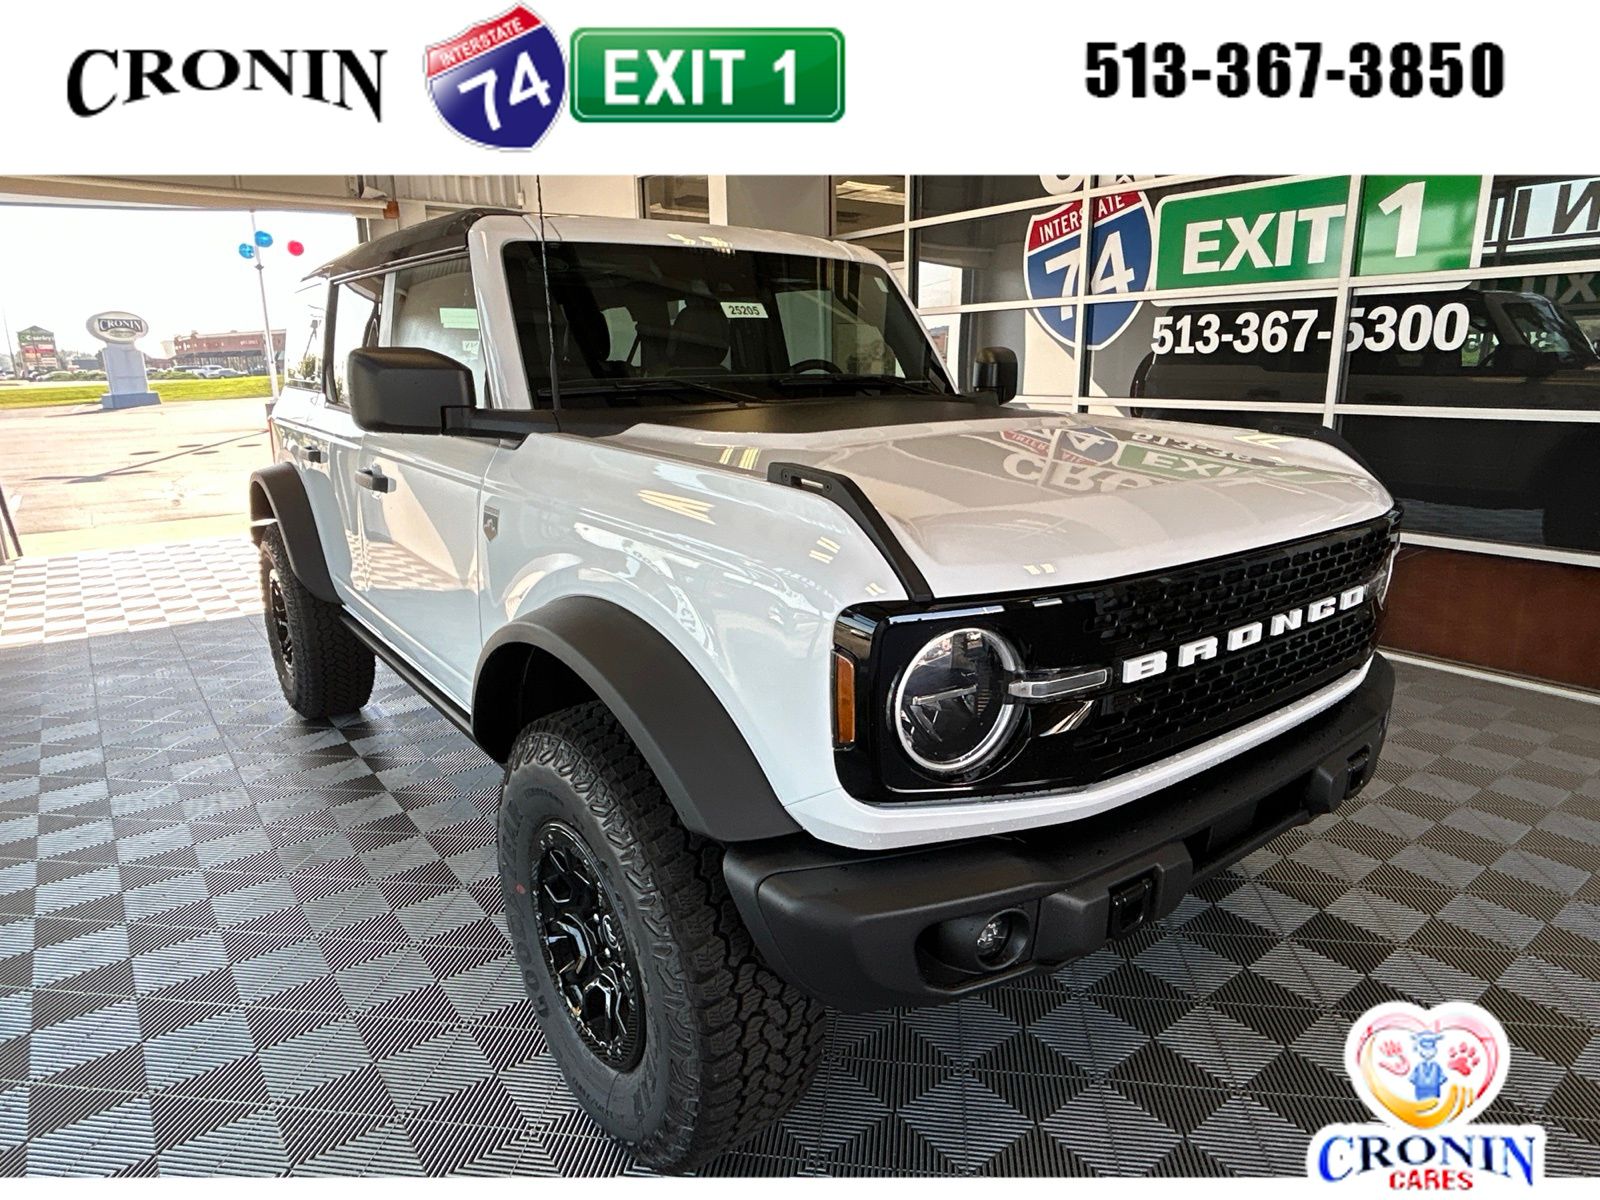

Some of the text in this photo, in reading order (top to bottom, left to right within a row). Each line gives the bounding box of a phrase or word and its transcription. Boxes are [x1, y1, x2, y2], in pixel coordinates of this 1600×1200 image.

[1183, 203, 1347, 275] EXIT
[1378, 180, 1426, 259] 1
[728, 305, 760, 316] 25205
[1044, 230, 1135, 322] 74
[98, 318, 143, 332] CRONIN
[1150, 302, 1470, 355] 513-367-5300
[1122, 585, 1364, 684] BRONCO
